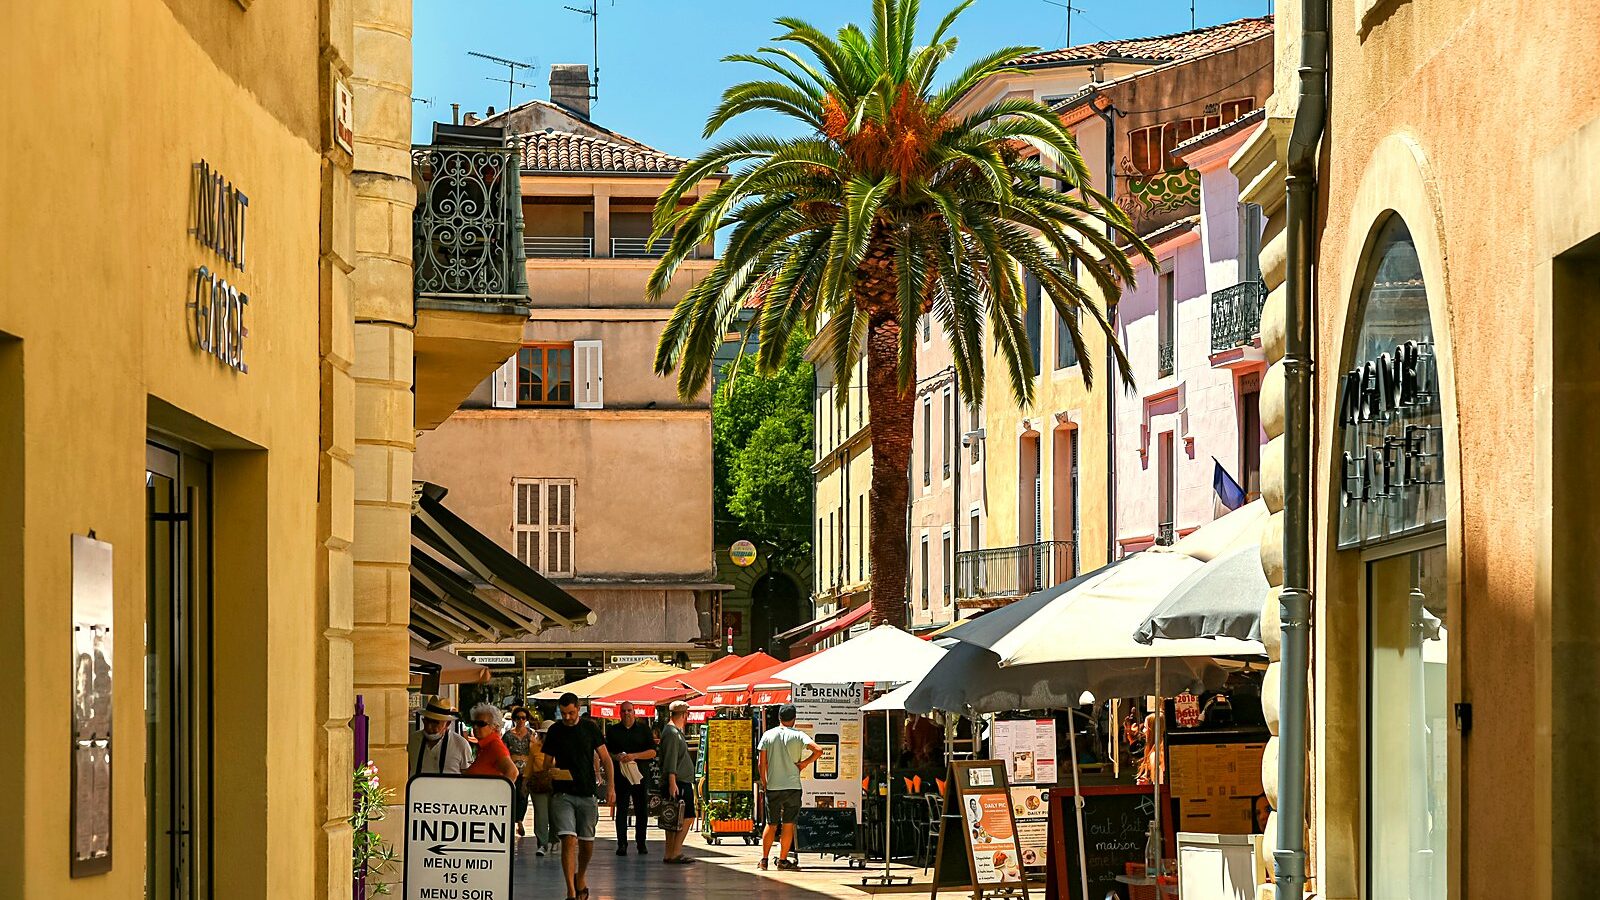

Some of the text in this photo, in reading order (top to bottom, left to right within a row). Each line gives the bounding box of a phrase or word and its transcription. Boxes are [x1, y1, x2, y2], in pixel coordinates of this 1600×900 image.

[795, 688, 861, 697] LE BRENNUS
[413, 802, 507, 816] RESTAURANT
[412, 819, 506, 844] INDIEN
[1096, 839, 1139, 851] maison
[423, 857, 493, 870] MENU MIDI
[443, 872, 468, 884] 15 €
[420, 888, 493, 900] MENU SOIR
